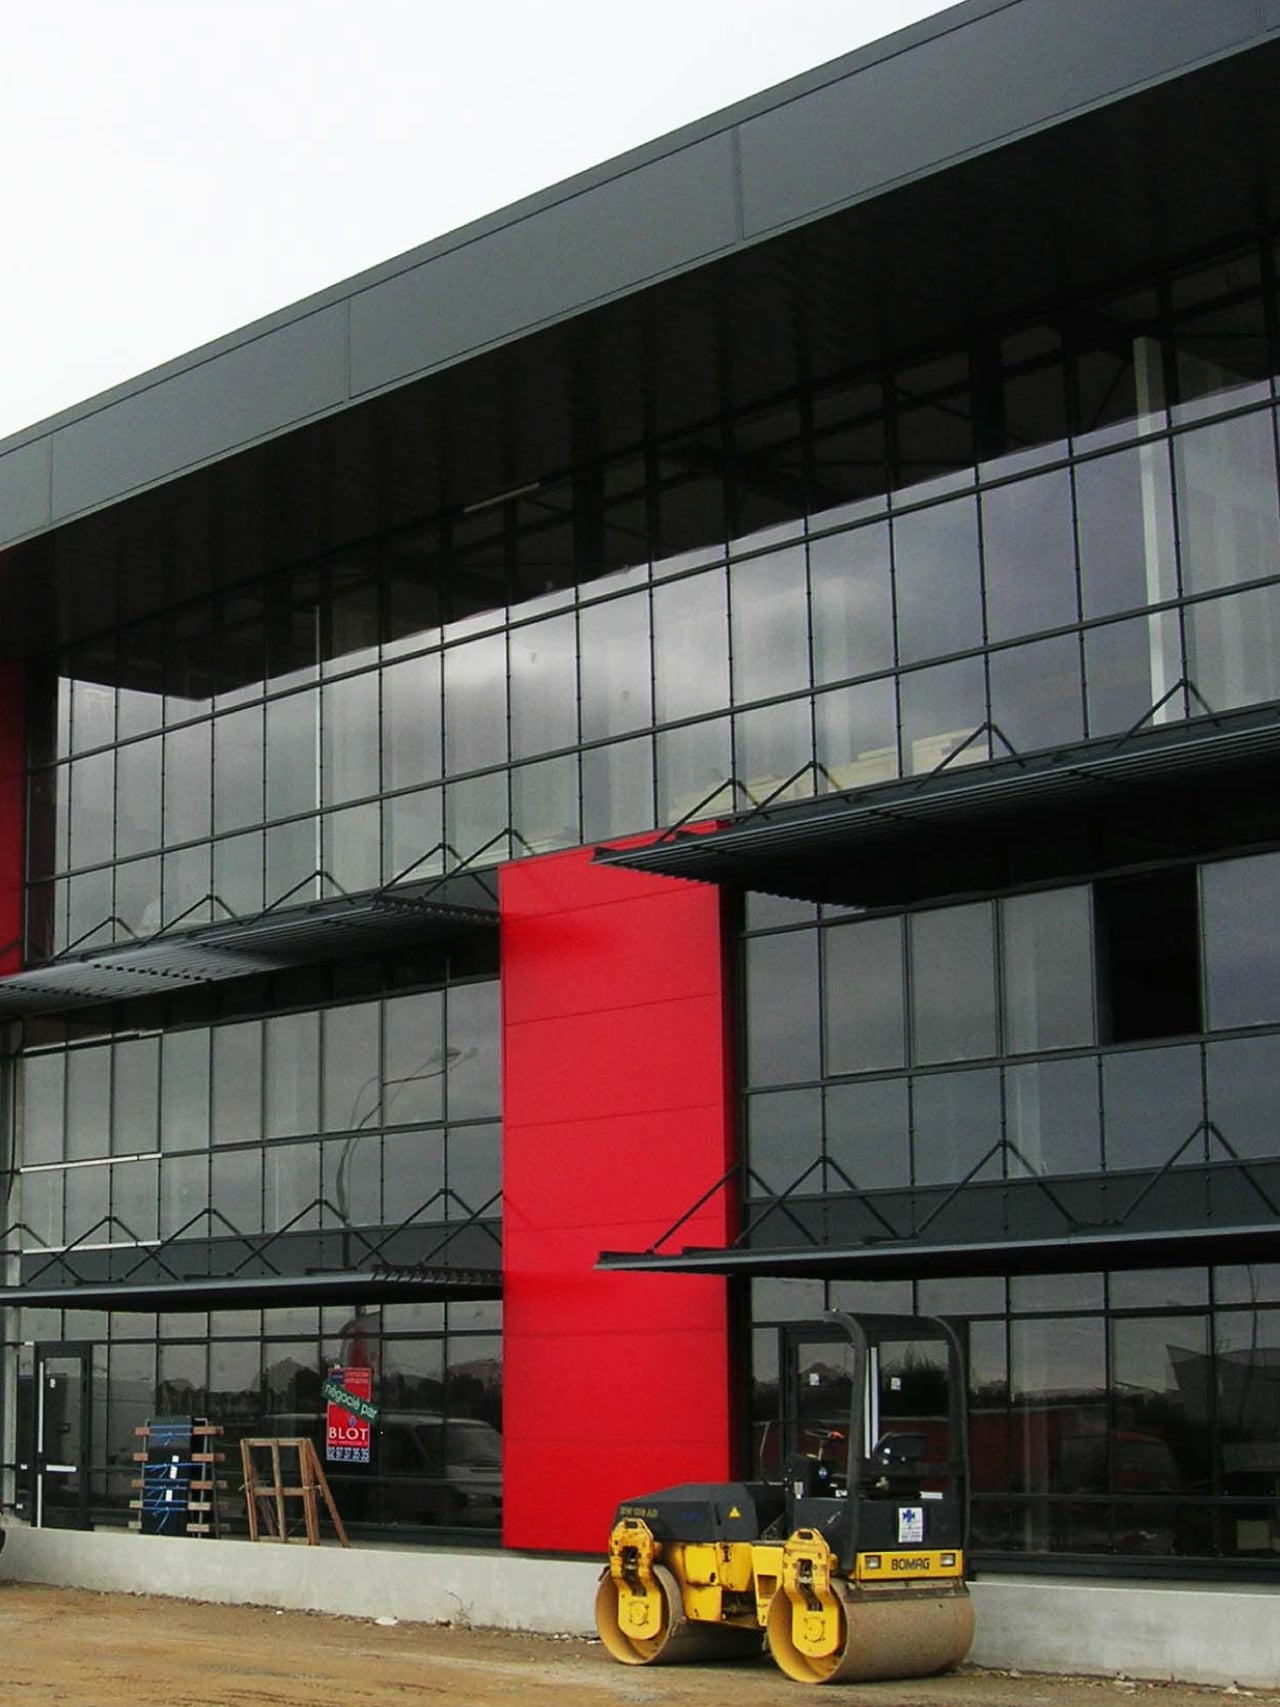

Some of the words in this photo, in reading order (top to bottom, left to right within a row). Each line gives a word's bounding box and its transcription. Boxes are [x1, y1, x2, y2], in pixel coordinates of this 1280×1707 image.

[325, 1383, 360, 1410] négocié
[360, 1404, 378, 1419] par
[329, 1426, 369, 1440] BLOT
[891, 1557, 930, 1571] BOMAG
